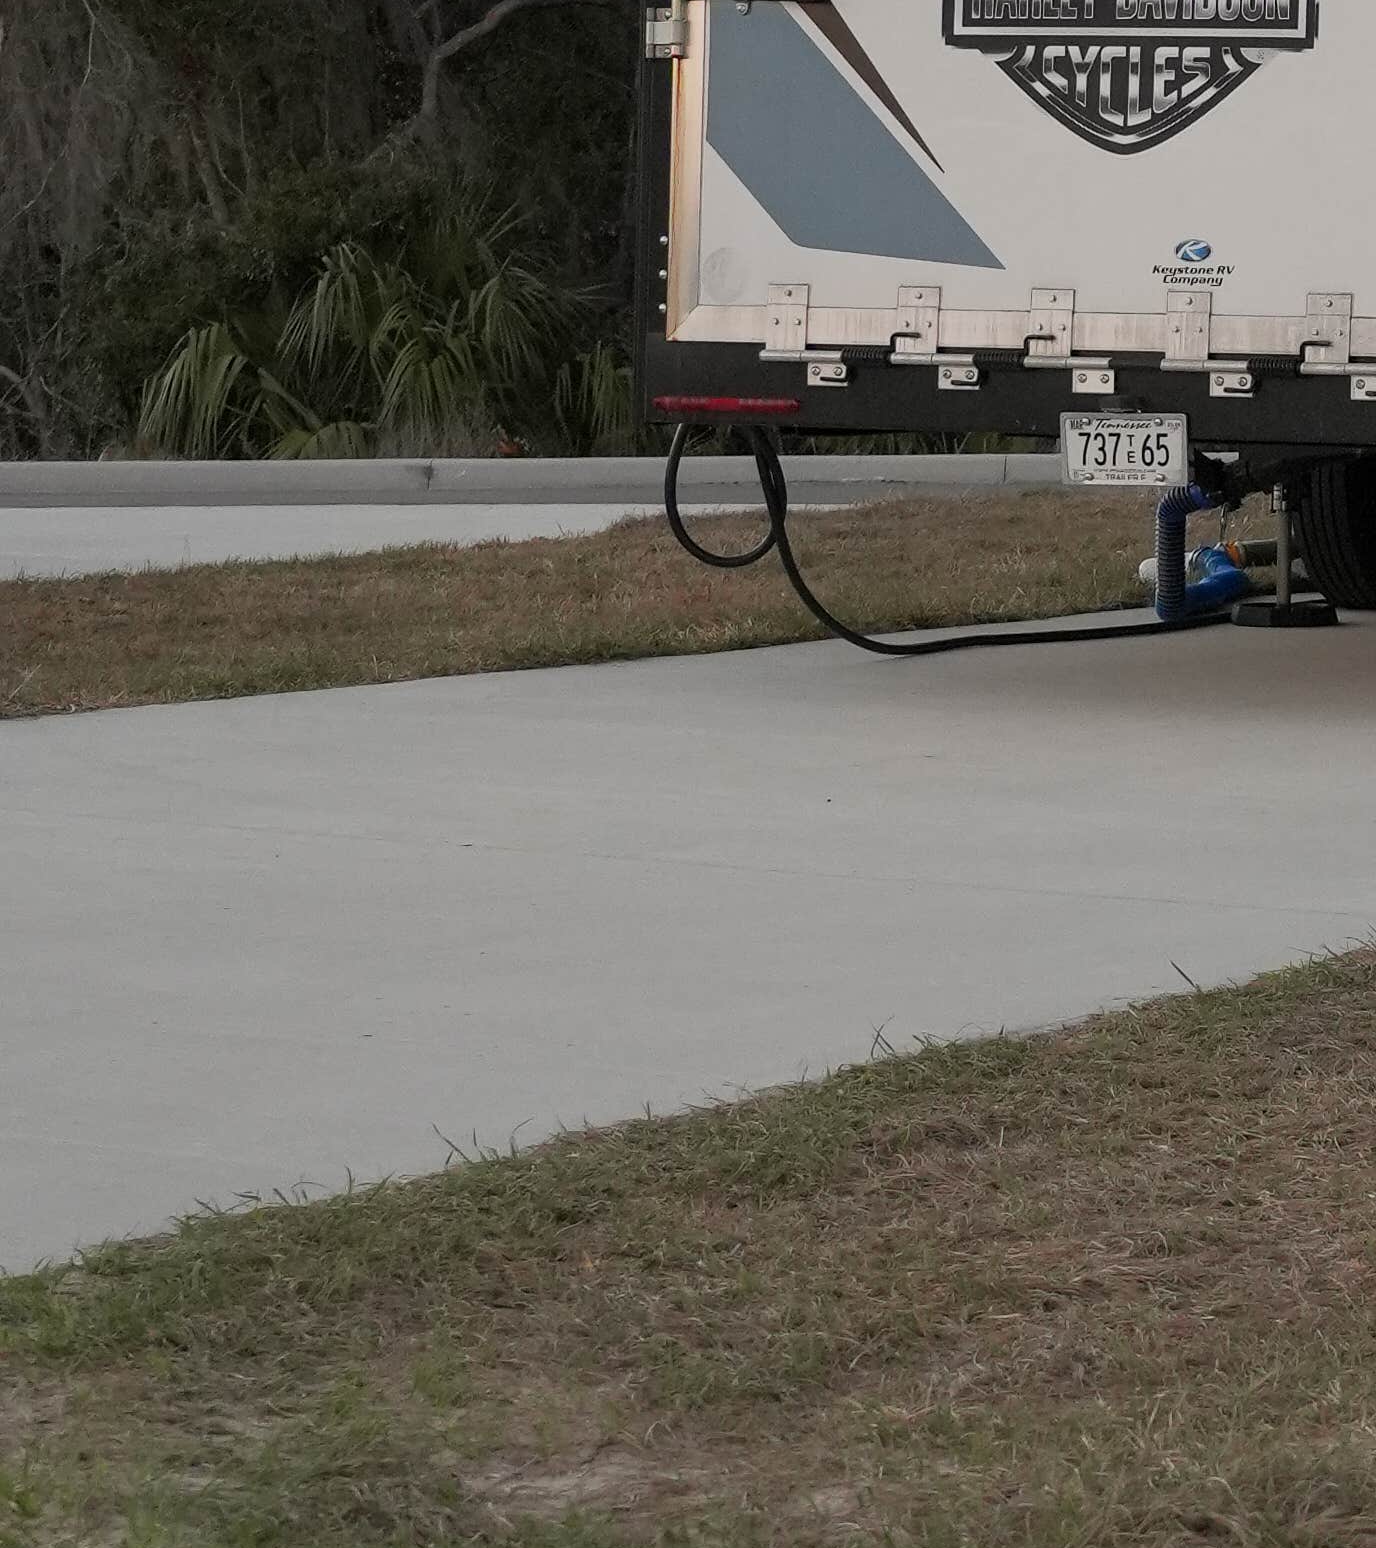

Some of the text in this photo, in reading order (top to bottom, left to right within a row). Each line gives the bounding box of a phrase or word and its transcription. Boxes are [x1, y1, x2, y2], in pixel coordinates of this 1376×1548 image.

[1042, 45, 1211, 126] CYCLES
[1152, 264, 1236, 277] Keystone RV
[1163, 274, 1224, 287] Company
[1095, 418, 1153, 431] Tennessee
